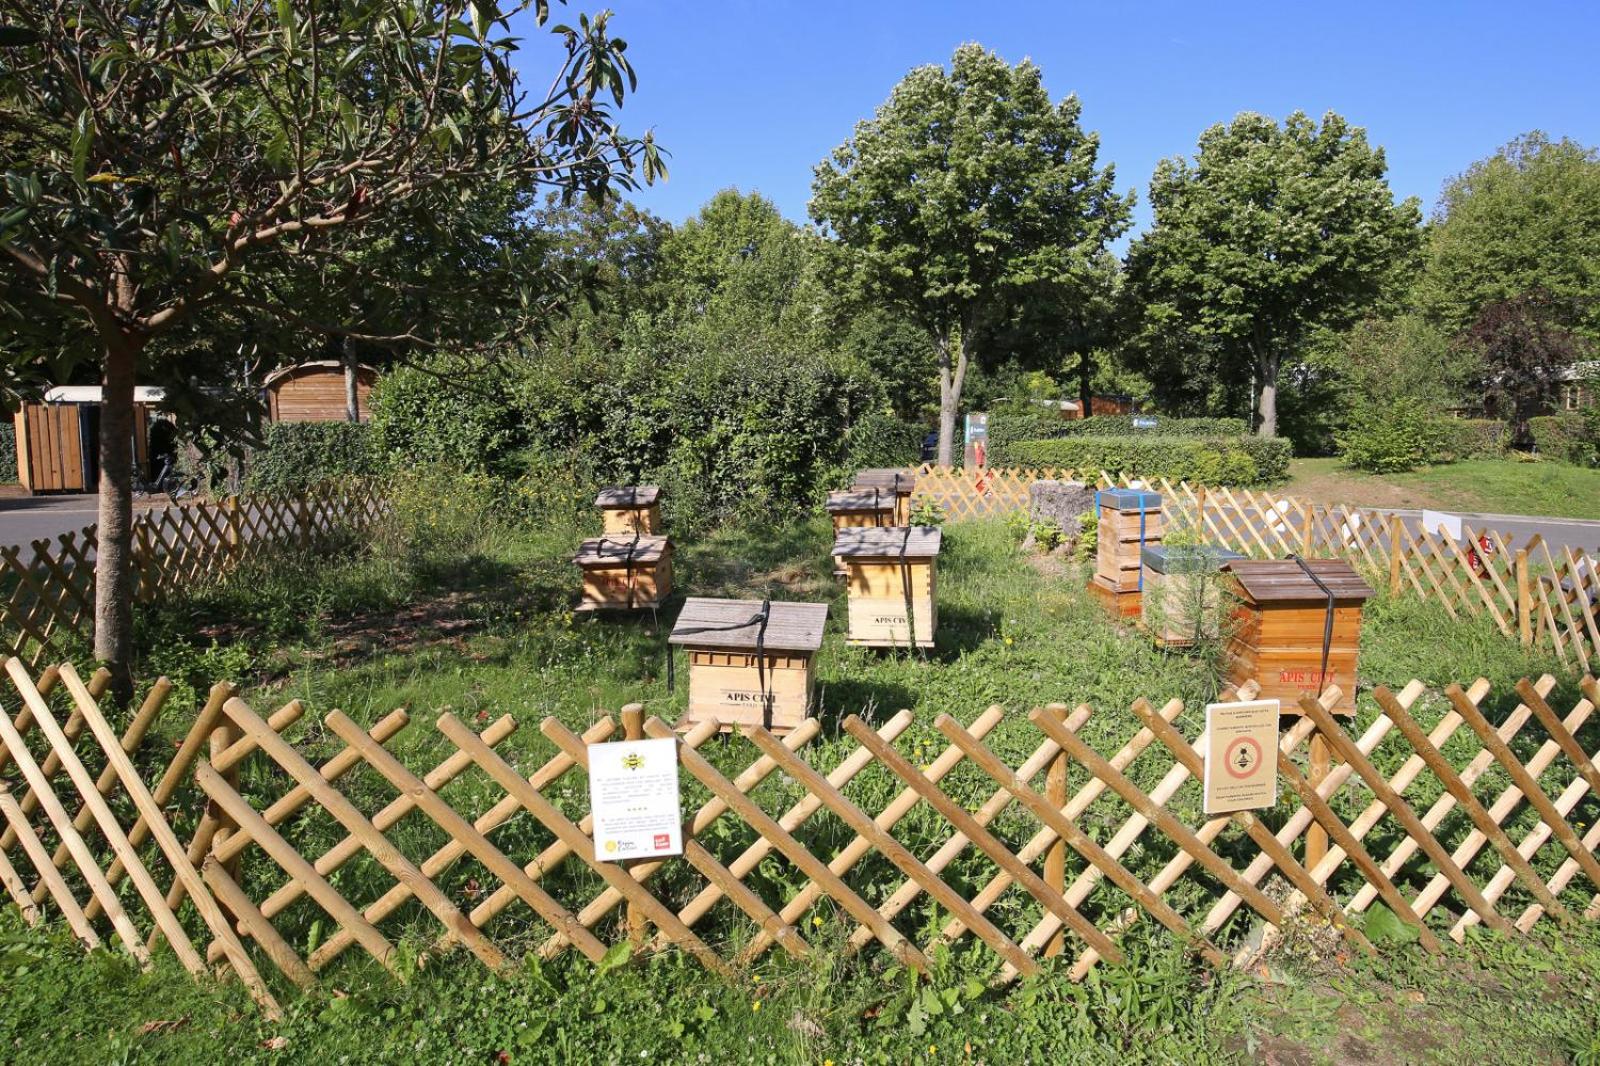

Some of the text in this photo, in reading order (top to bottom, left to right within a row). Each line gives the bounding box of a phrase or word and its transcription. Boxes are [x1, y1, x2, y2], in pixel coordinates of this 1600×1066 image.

[874, 616, 892, 625] APIS
[1280, 671, 1305, 683] APIS
[726, 692, 751, 702] APIS
